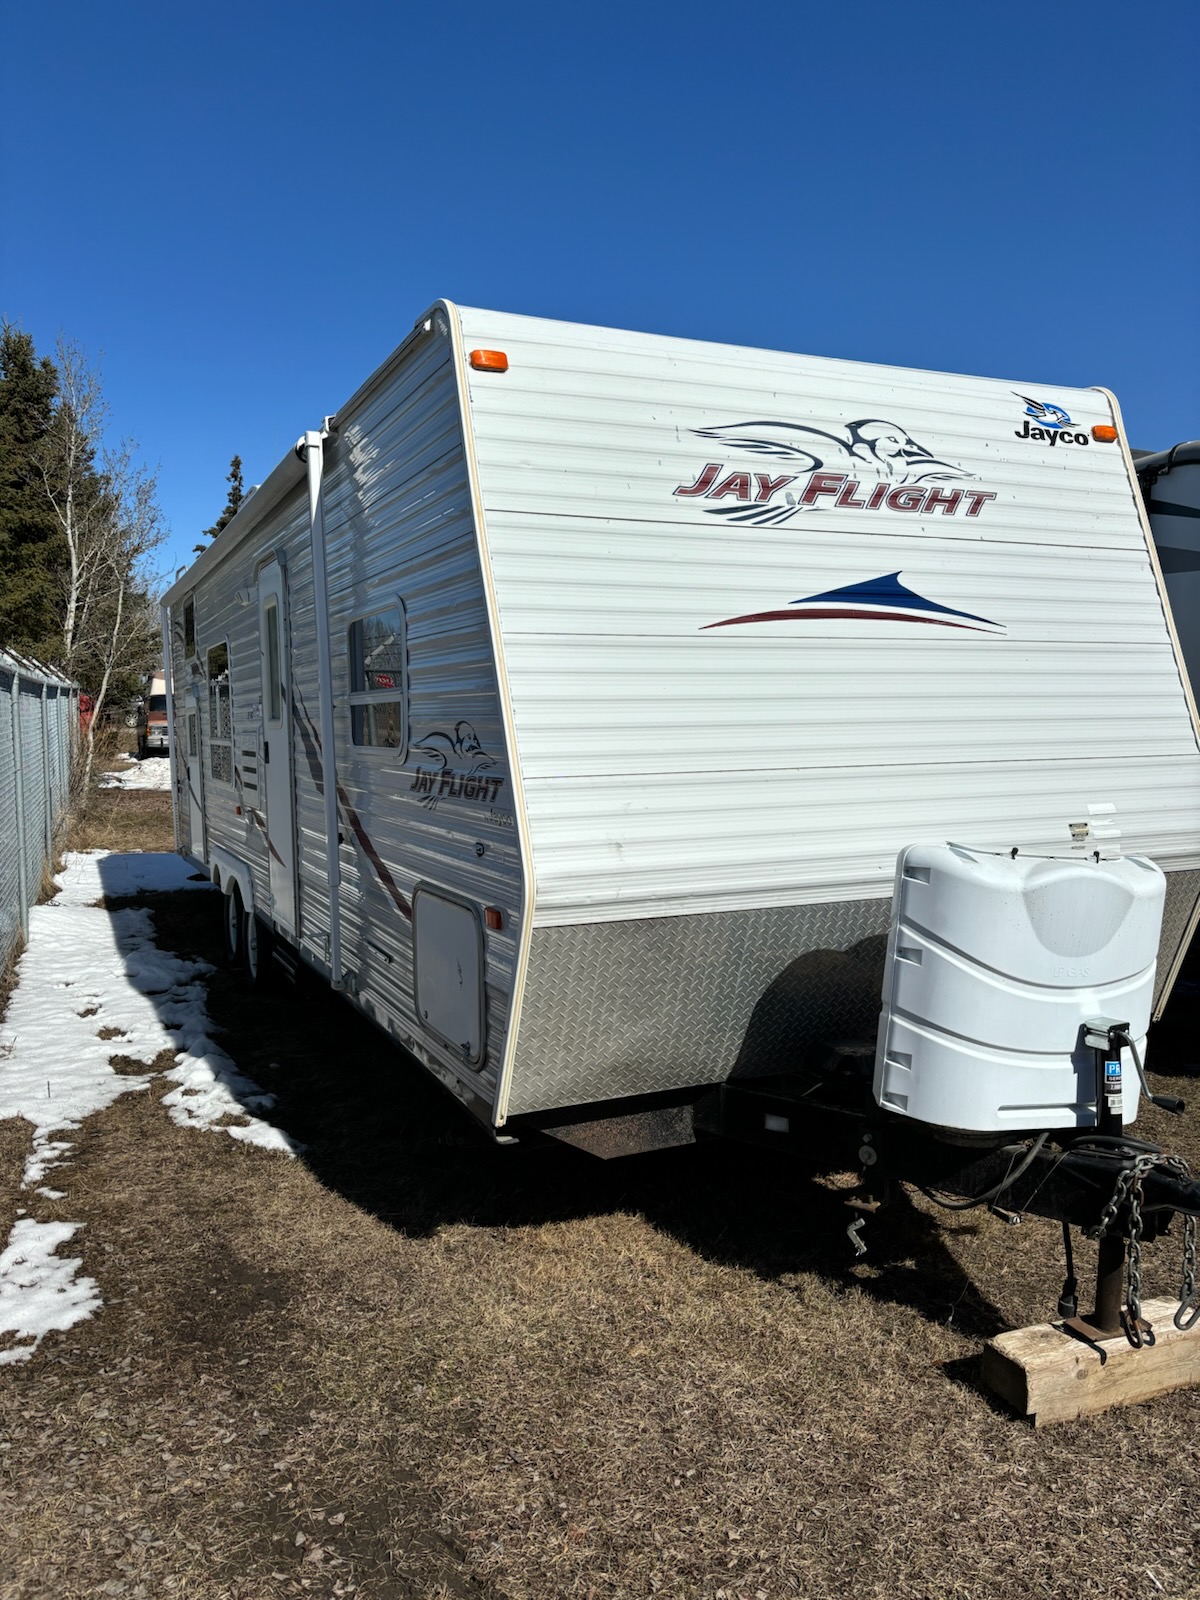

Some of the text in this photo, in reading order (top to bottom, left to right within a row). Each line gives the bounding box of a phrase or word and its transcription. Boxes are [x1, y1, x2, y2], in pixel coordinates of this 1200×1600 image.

[1015, 420, 1089, 447] Jayco
[673, 463, 997, 517] JAY FLIGHT
[410, 766, 505, 803] JAY FLIGHT
